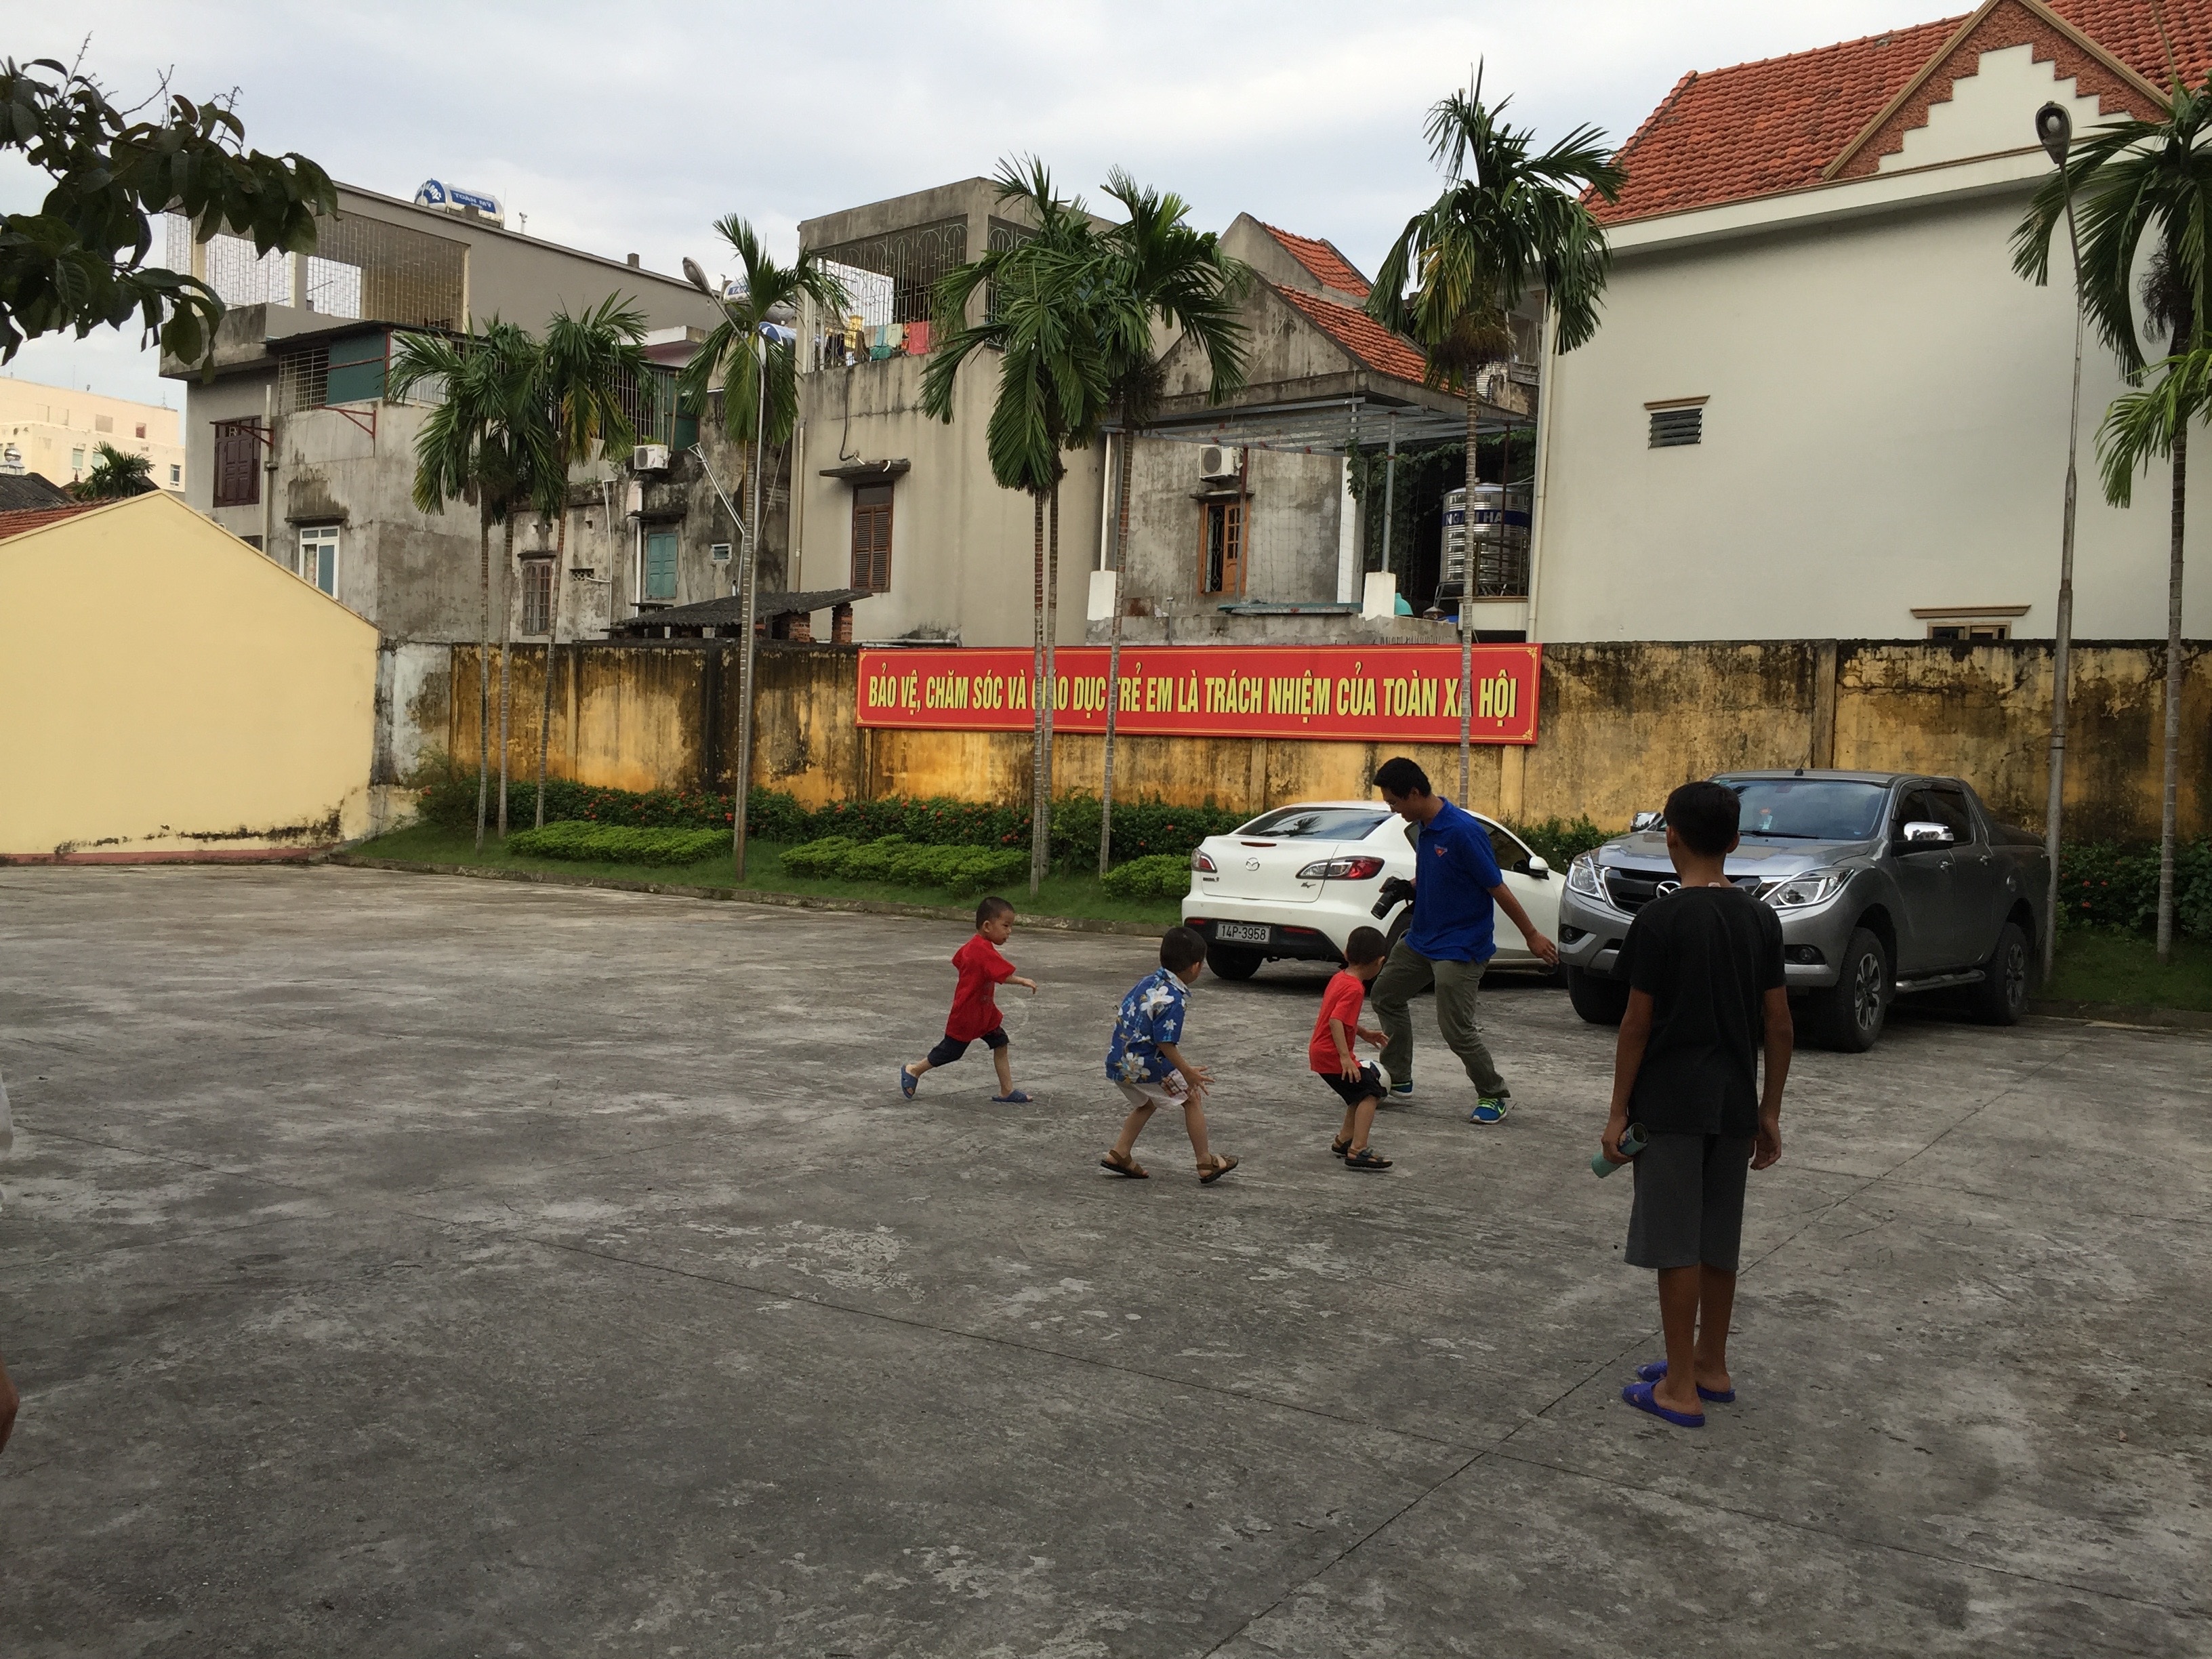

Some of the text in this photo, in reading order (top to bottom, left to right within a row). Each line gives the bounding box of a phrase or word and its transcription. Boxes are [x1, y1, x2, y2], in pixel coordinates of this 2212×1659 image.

[1446, 512, 1479, 525] NG
[869, 662, 897, 708] BẢO
[901, 670, 921, 716] VỆ,
[925, 669, 969, 710] CHĂM
[972, 669, 1003, 710] SÓC
[1008, 669, 1027, 710] VÀ
[1073, 676, 1107, 719] DỤC
[1146, 677, 1173, 713] EM
[1177, 669, 1199, 713] LÀ
[1204, 669, 1263, 714] TRÁCH
[1267, 669, 1331, 724] NHIỆM
[1336, 661, 1376, 716] CỦA
[1382, 669, 1437, 717] TOÀN
[1442, 677, 1472, 718] X
[1478, 669, 1517, 727] HỘI
[1222, 924, 1267, 941] 14P-3958
